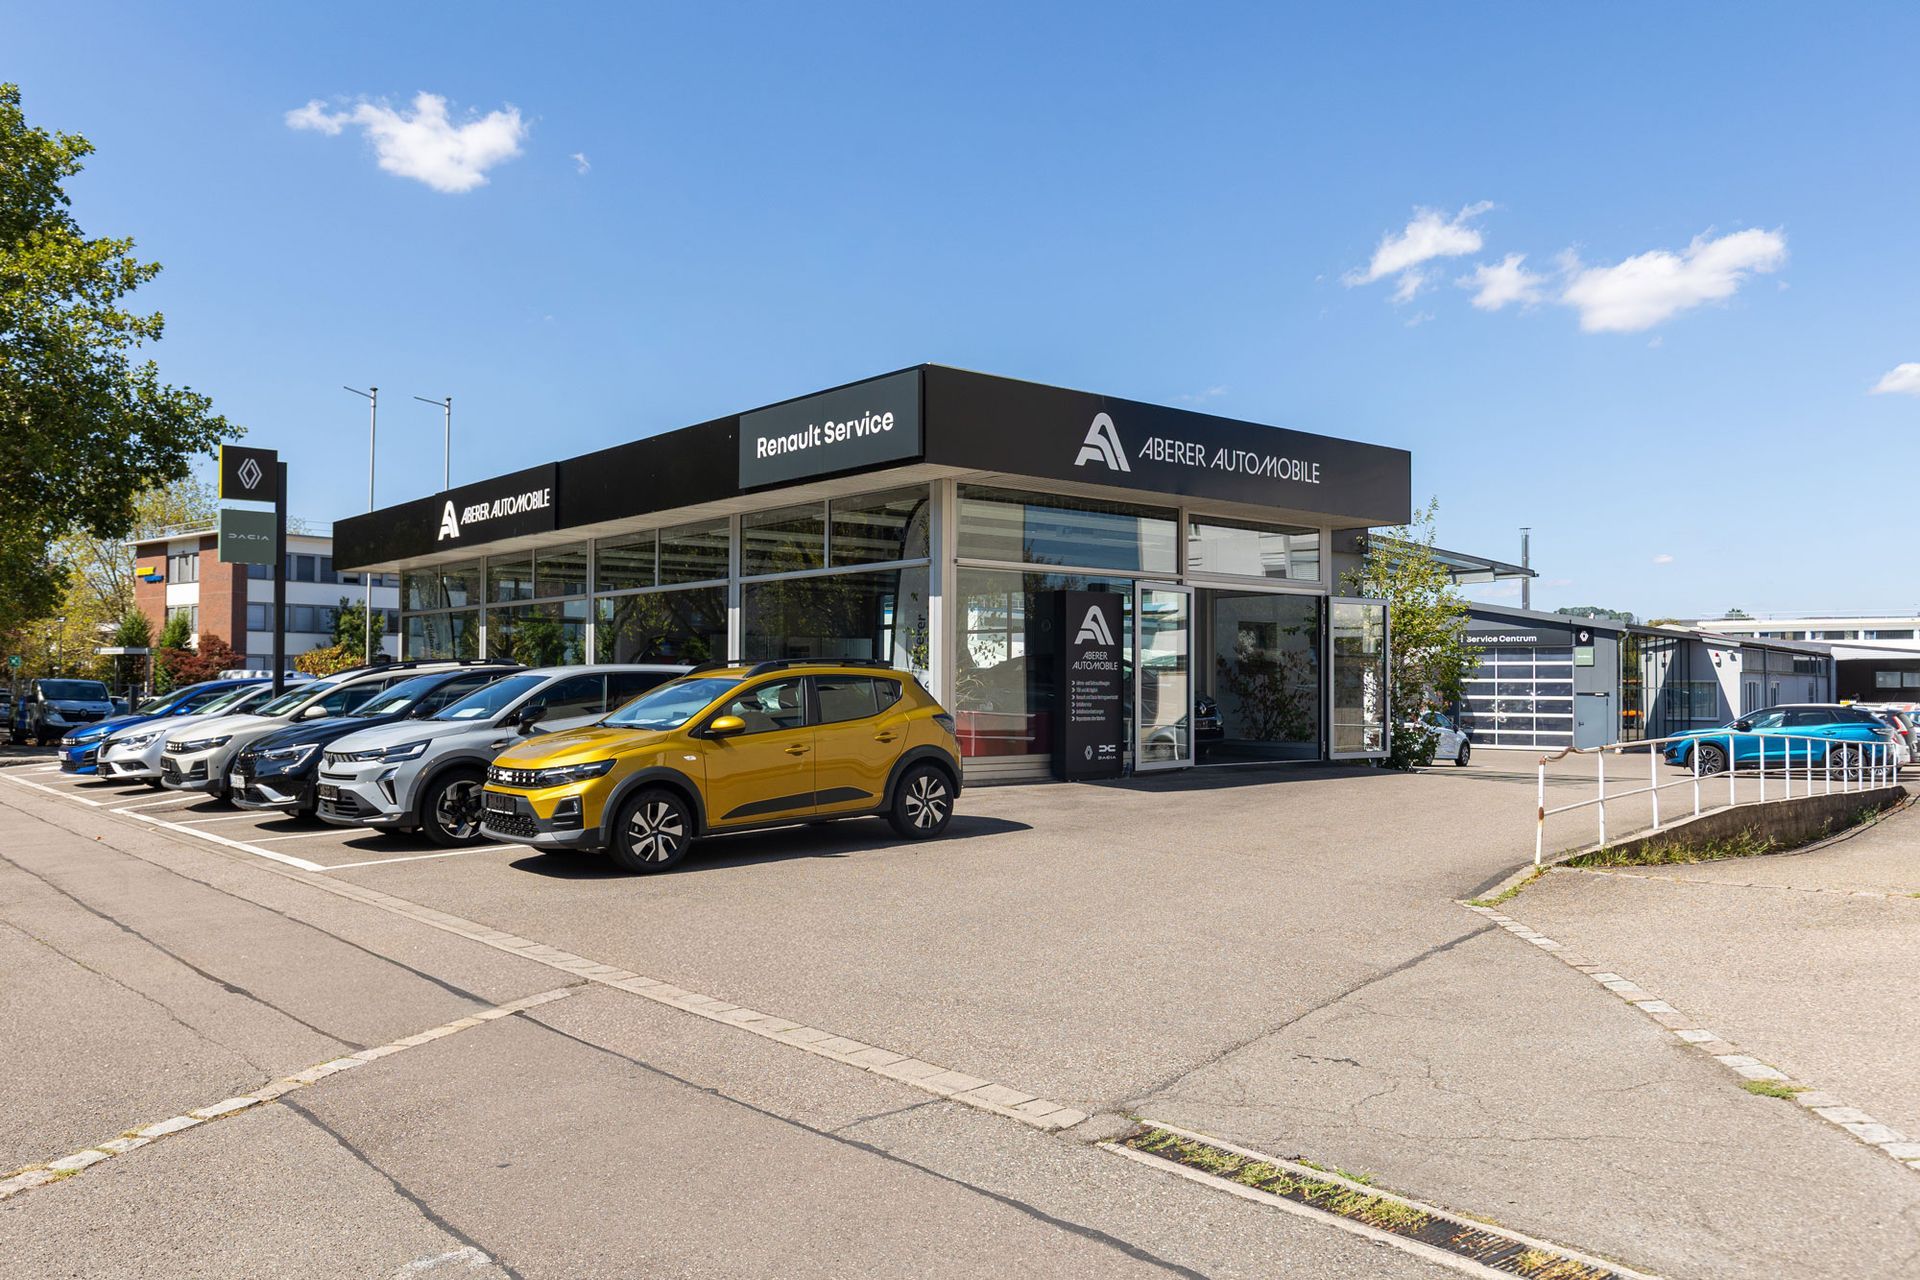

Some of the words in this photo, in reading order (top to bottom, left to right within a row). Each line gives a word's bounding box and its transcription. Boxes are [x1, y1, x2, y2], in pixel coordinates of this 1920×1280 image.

[757, 424, 821, 459] Renault
[824, 410, 894, 444] Service
[1138, 437, 1206, 468] ABERER
[1211, 448, 1320, 484] AUTOMOBILE
[460, 502, 490, 526] ABERER
[490, 488, 550, 519] AUTOMOBILE
[227, 533, 270, 541] DACIA
[1466, 634, 1498, 643] Service
[1499, 635, 1537, 643] Centrum
[1082, 651, 1108, 660] ABERER
[1071, 661, 1119, 670] AUTOMOBILE
